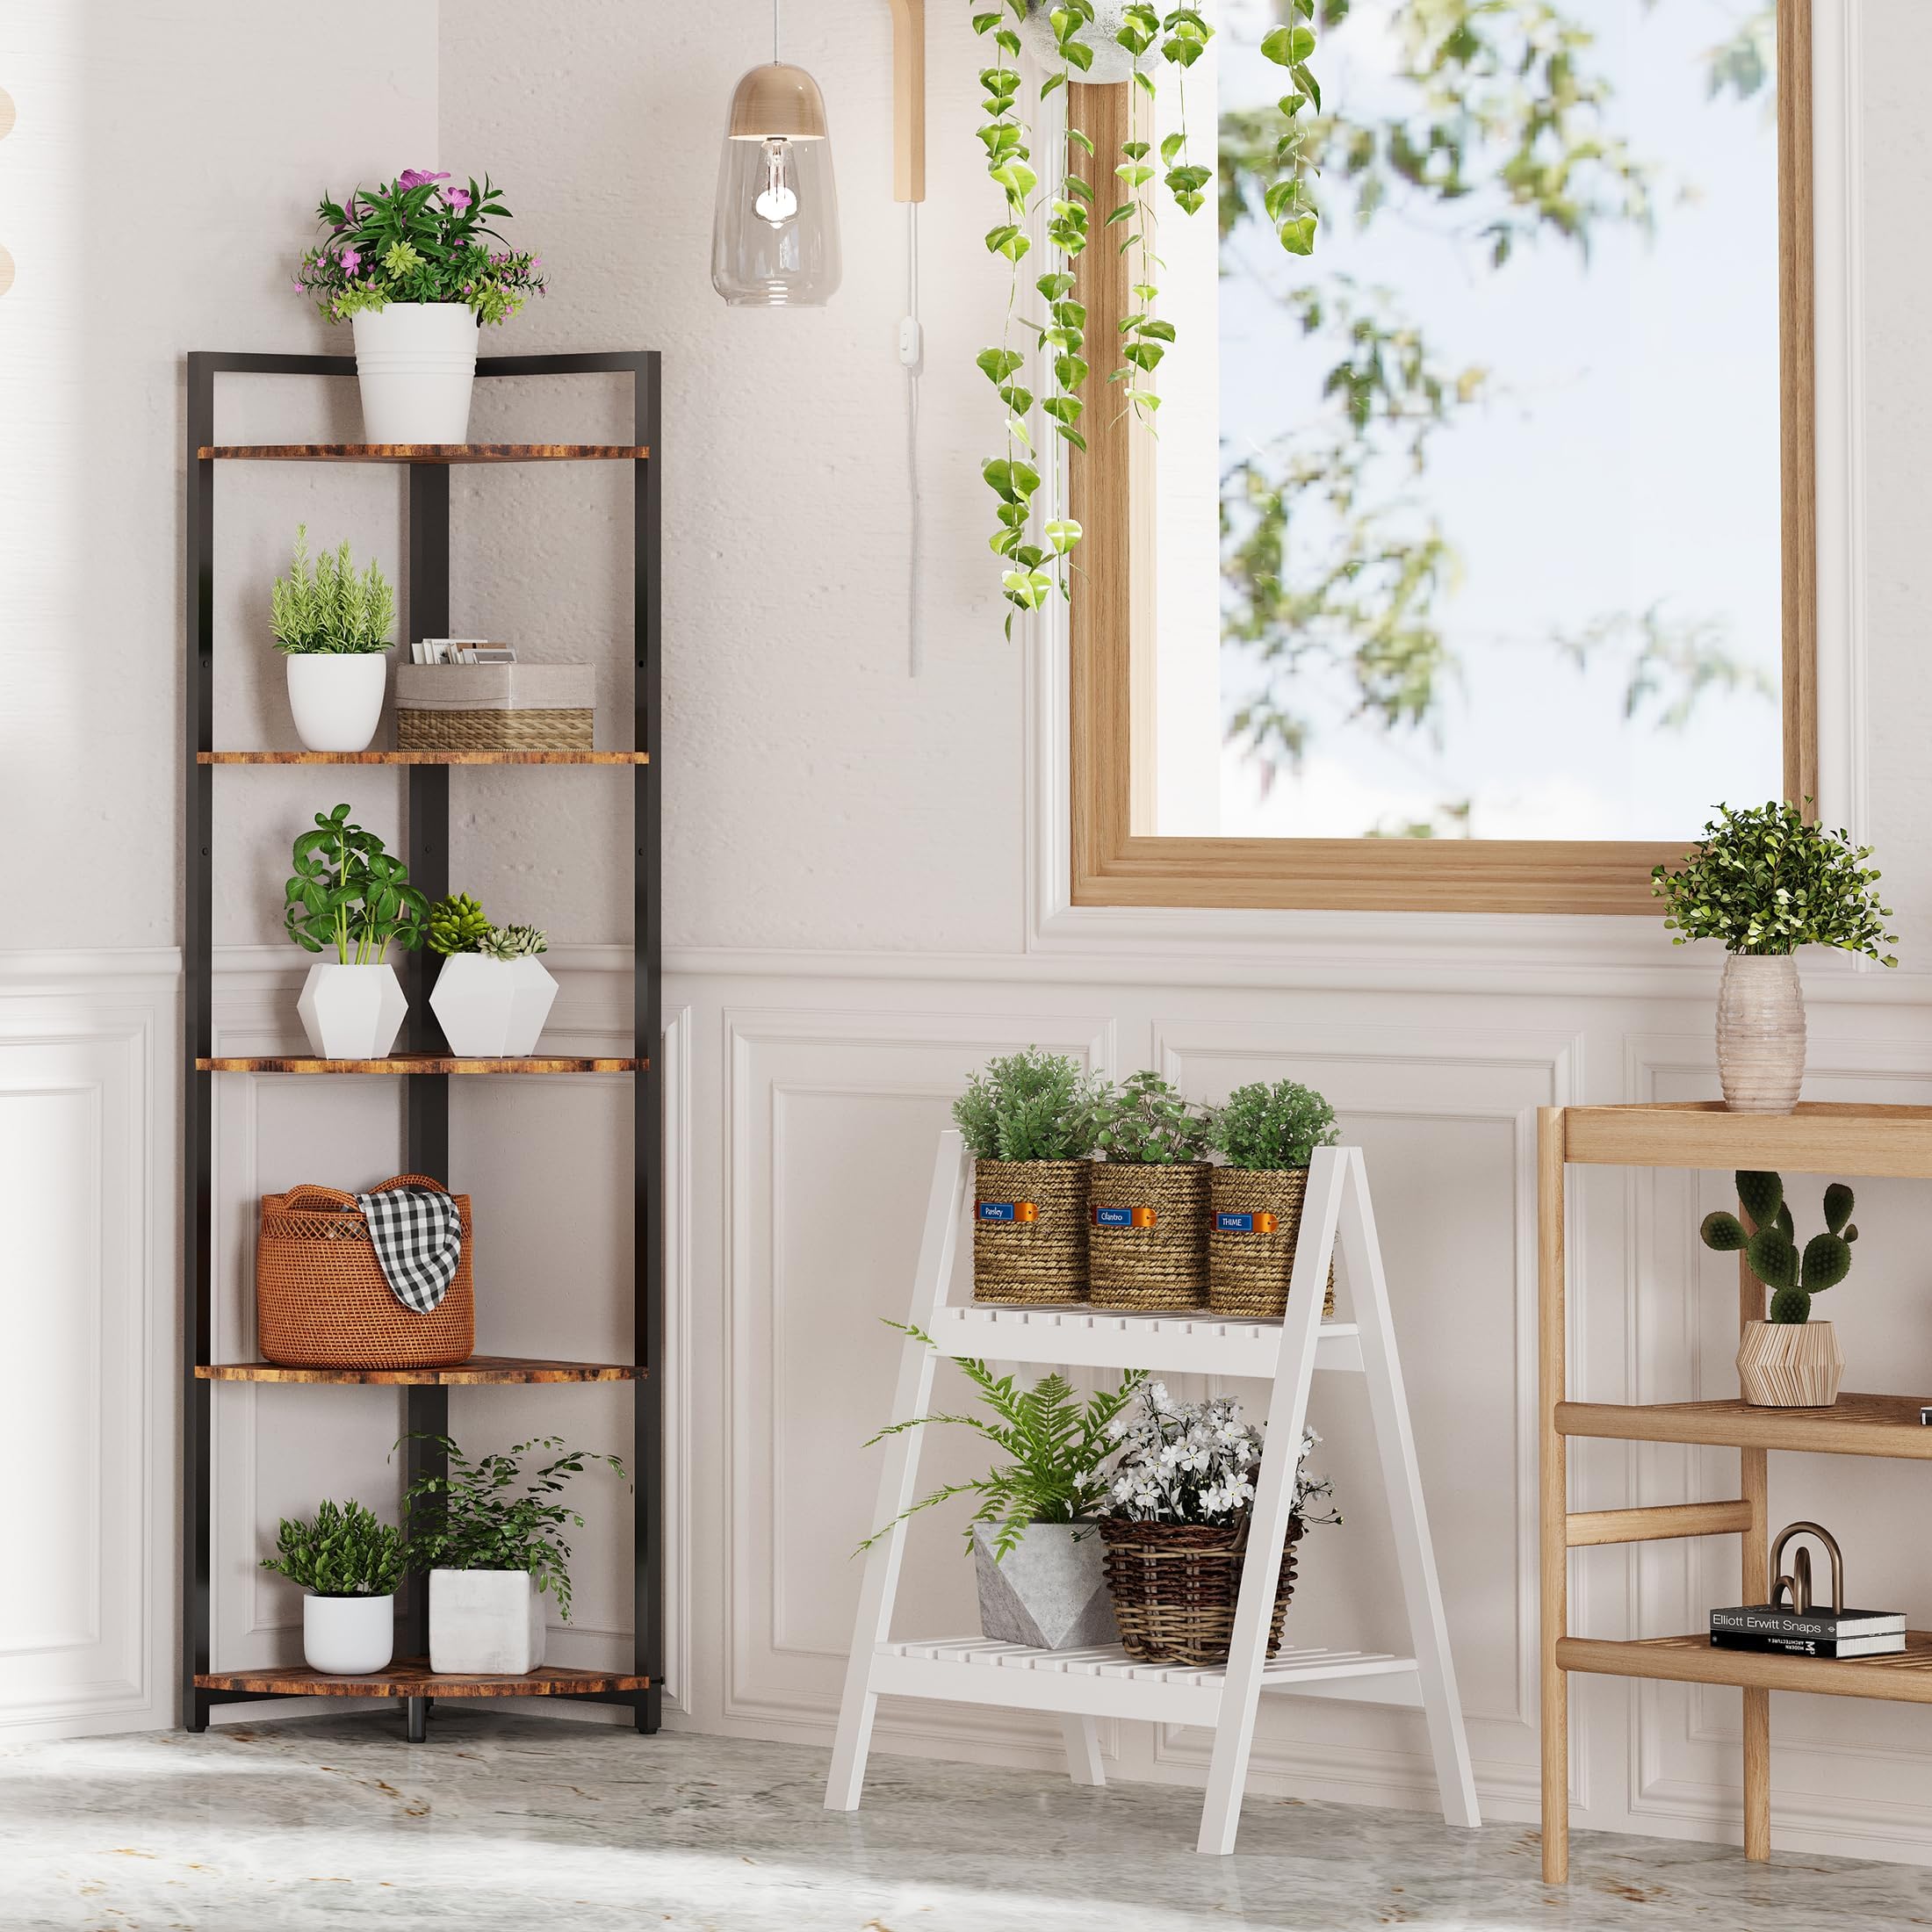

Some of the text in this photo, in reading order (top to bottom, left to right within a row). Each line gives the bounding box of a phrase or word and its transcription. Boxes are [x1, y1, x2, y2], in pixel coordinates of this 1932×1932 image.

[1100, 1212, 1123, 1221] Cilantro
[1222, 1218, 1243, 1227] THIME
[1713, 1614, 1821, 1634] Elliott Erwitt Snaps
